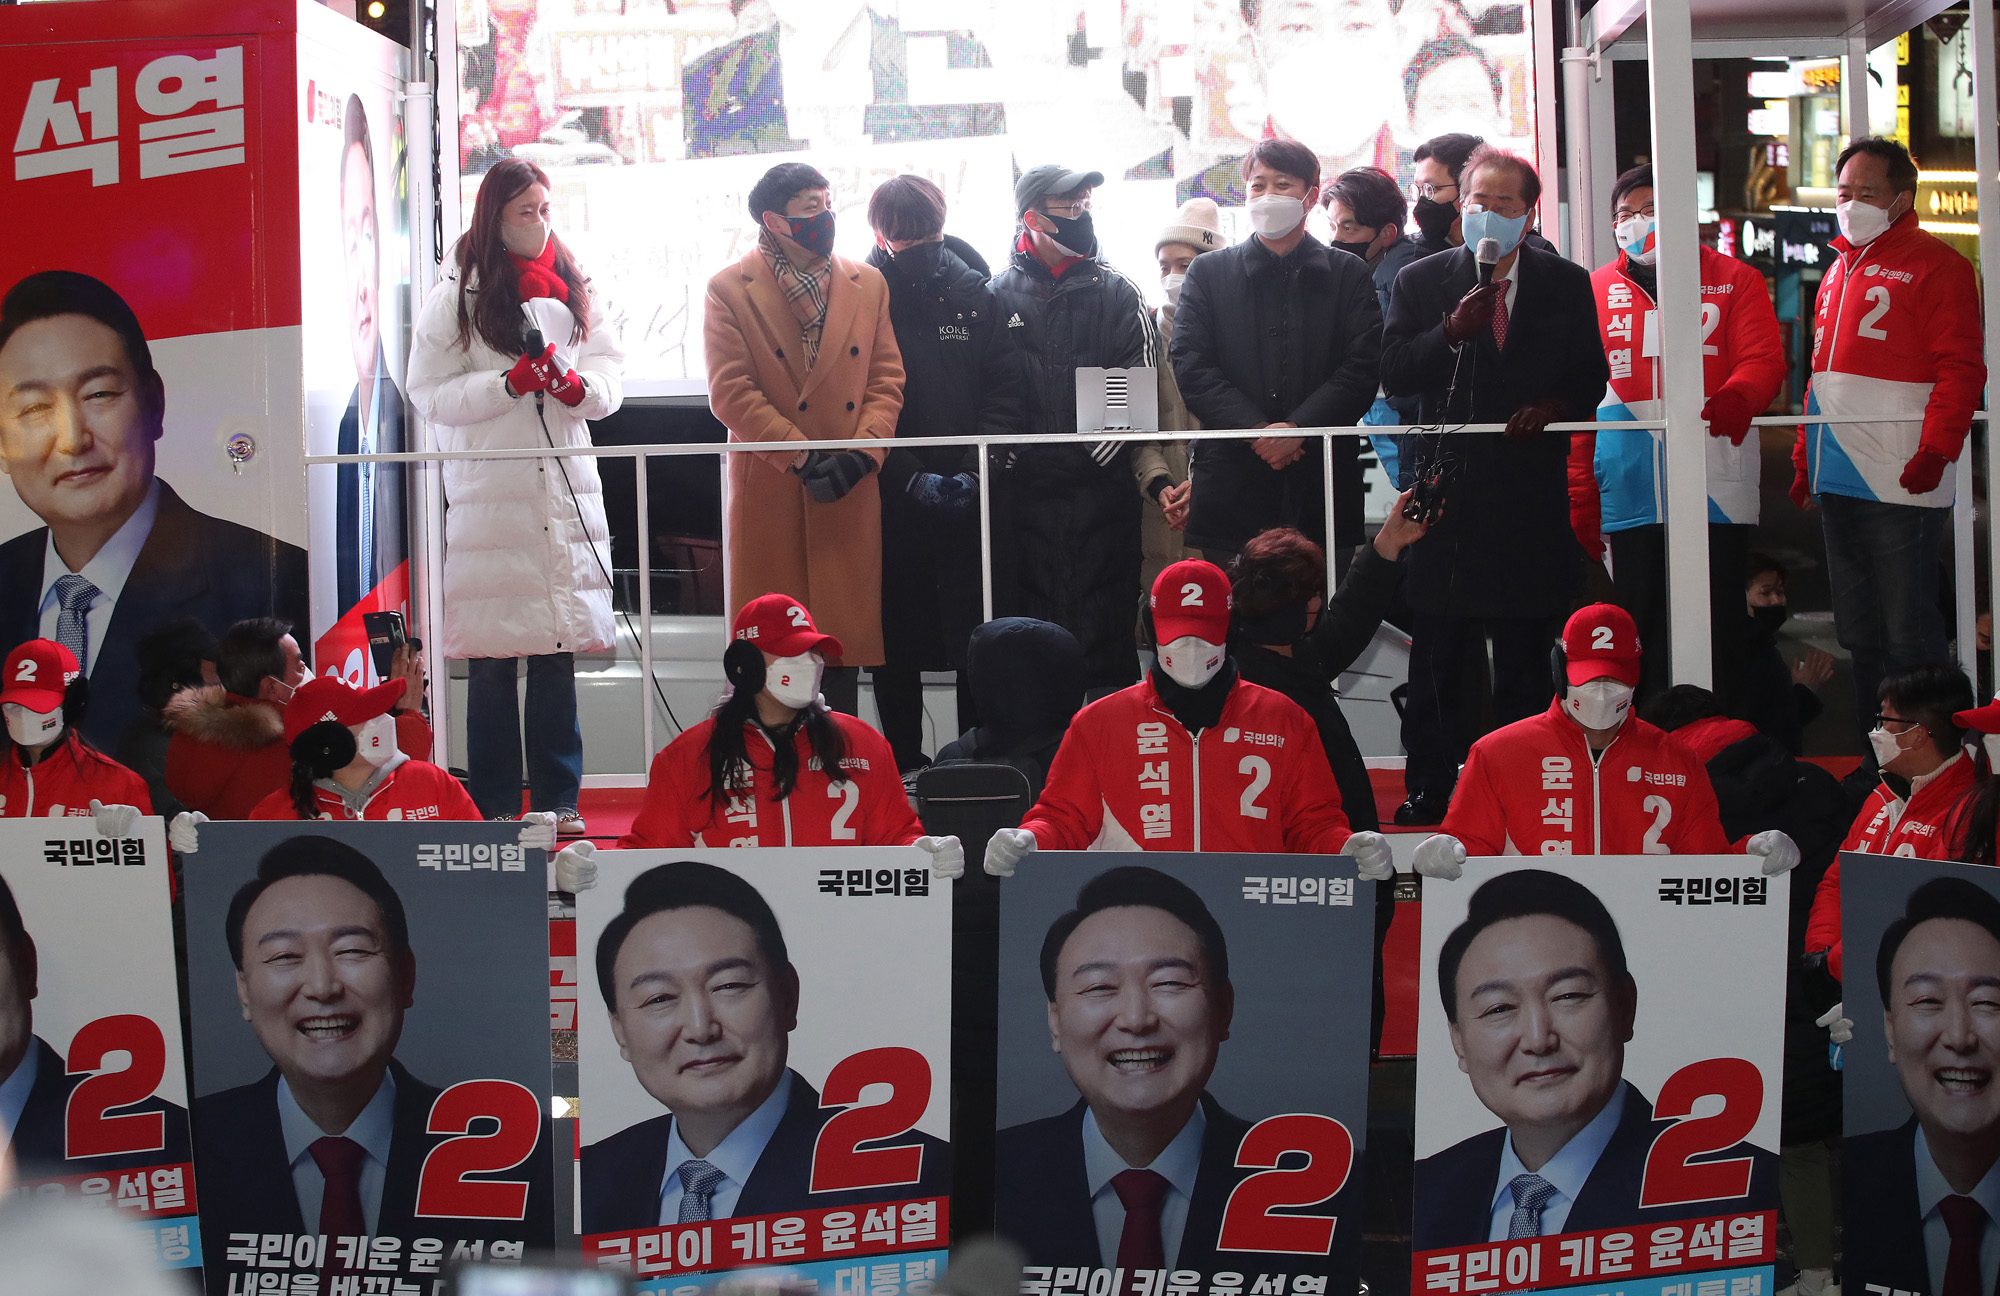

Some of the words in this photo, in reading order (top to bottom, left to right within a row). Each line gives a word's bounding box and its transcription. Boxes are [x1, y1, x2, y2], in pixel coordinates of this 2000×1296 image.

[13, 46, 245, 187] 석열
[1879, 268, 1914, 284] 국민의힘
[1857, 286, 1891, 341] 2
[939, 326, 970, 336] KORE
[1607, 283, 1632, 380] 윤석열
[1701, 303, 1720, 356] 2
[1181, 583, 1204, 607] 2
[786, 606, 810, 627] 2
[1591, 626, 1614, 650] 2
[15, 659, 38, 682] 2
[1165, 656, 1172, 667] 2
[781, 675, 790, 686] 2
[1573, 699, 1580, 710] 2
[372, 736, 379, 747] 2
[1244, 731, 1284, 749] 국민의힘
[839, 757, 870, 771] 민의힘
[1644, 771, 1687, 787] 국민의힘
[1137, 722, 1171, 839] 윤석열
[1238, 755, 1271, 820] 2
[827, 780, 859, 840] 2
[1642, 795, 1672, 854] 2
[44, 838, 146, 867] 국민의힘
[417, 843, 526, 871] 국민의힘
[818, 869, 929, 897] 국민의힘
[1242, 876, 1354, 906] 국민의힘
[1658, 876, 1768, 906] 국민의힘
[64, 1014, 166, 1160] 2
[809, 1047, 932, 1194] 2
[1639, 1057, 1764, 1209] 2
[414, 1079, 541, 1220] 2
[1217, 1113, 1354, 1255] 2
[226, 1233, 328, 1268] 국민이
[335, 1235, 402, 1271] 키운
[597, 1226, 712, 1275] 국민이
[731, 1216, 806, 1260] 키운
[821, 1200, 937, 1253] 윤석열
[1426, 1242, 1541, 1293] 국민이
[1559, 1231, 1634, 1277] 키운
[1650, 1214, 1764, 1269] 윤석열
[1018, 1266, 1125, 1296] 국민이
